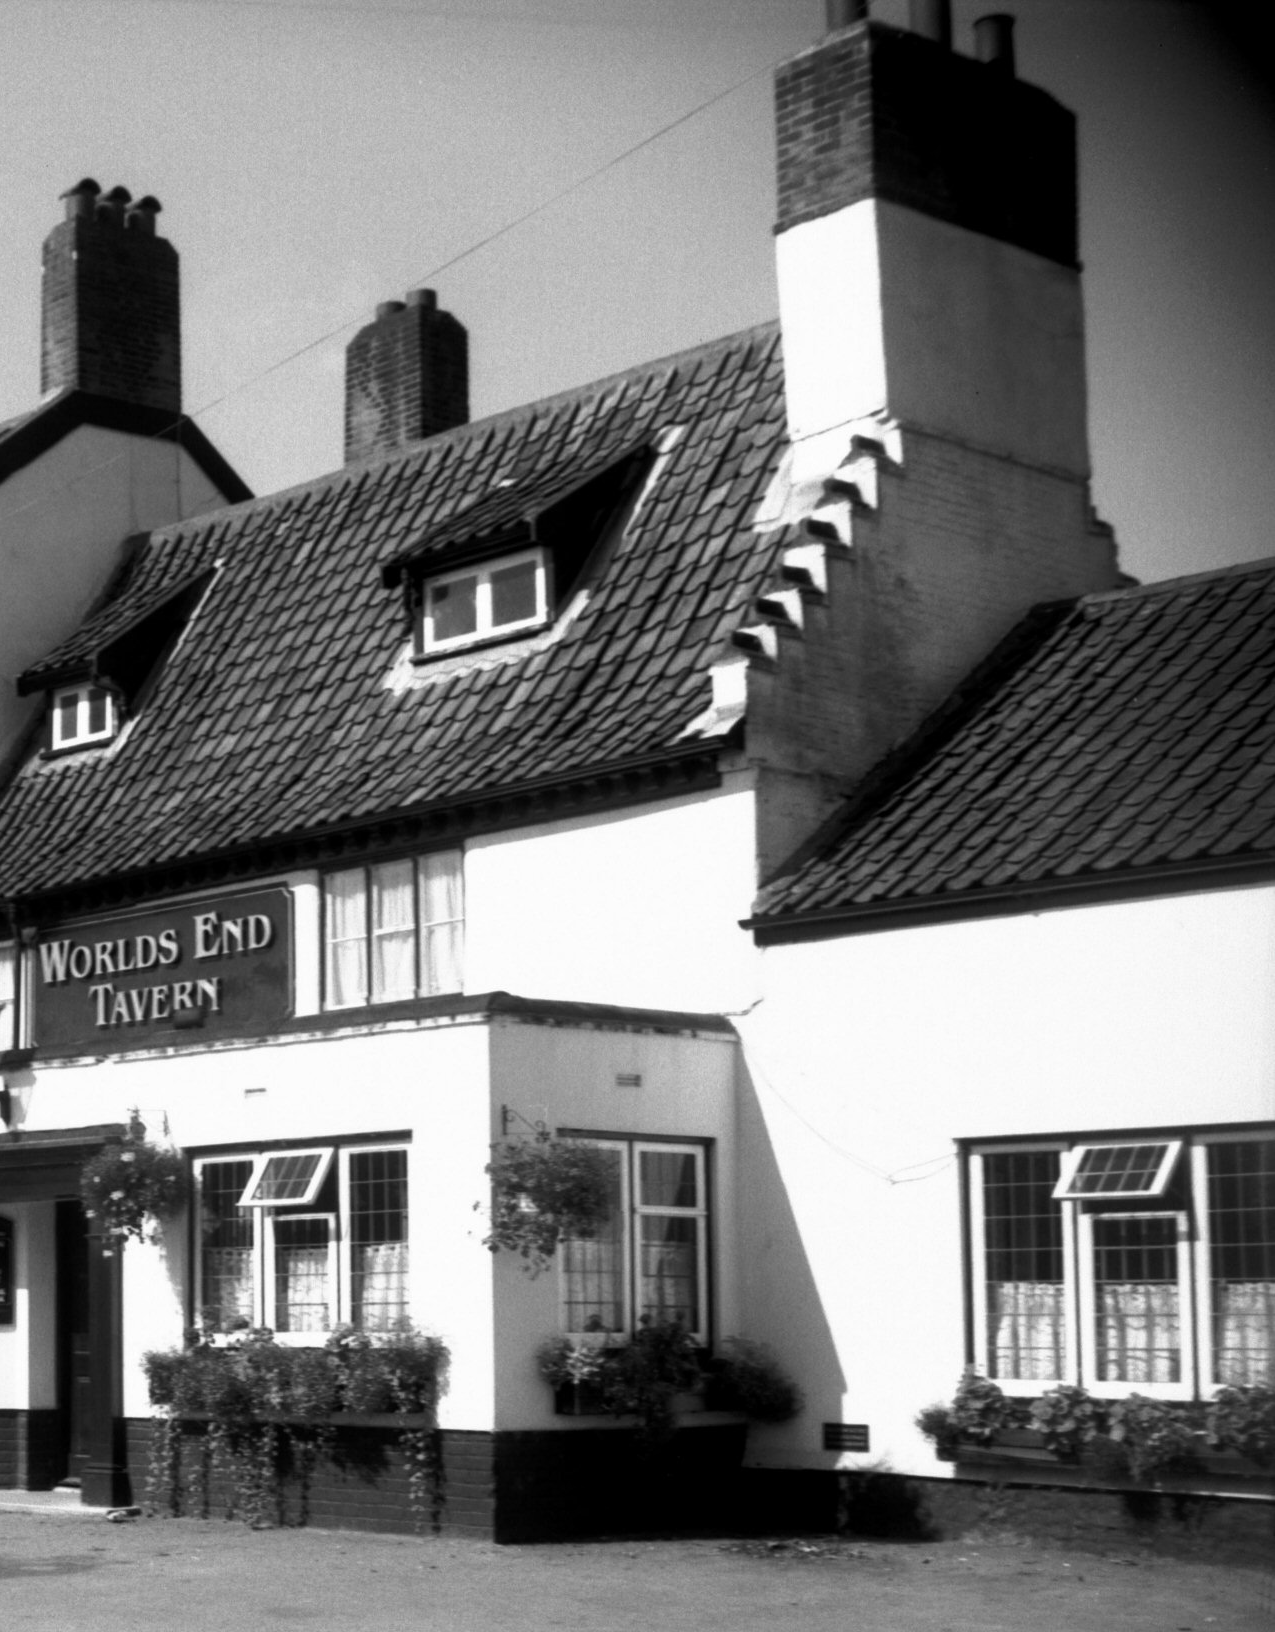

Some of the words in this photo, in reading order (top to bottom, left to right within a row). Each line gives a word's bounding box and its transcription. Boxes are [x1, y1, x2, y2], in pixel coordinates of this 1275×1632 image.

[38, 928, 179, 984] WORLDS
[192, 911, 272, 959] END
[87, 976, 221, 1027] TAVERN
